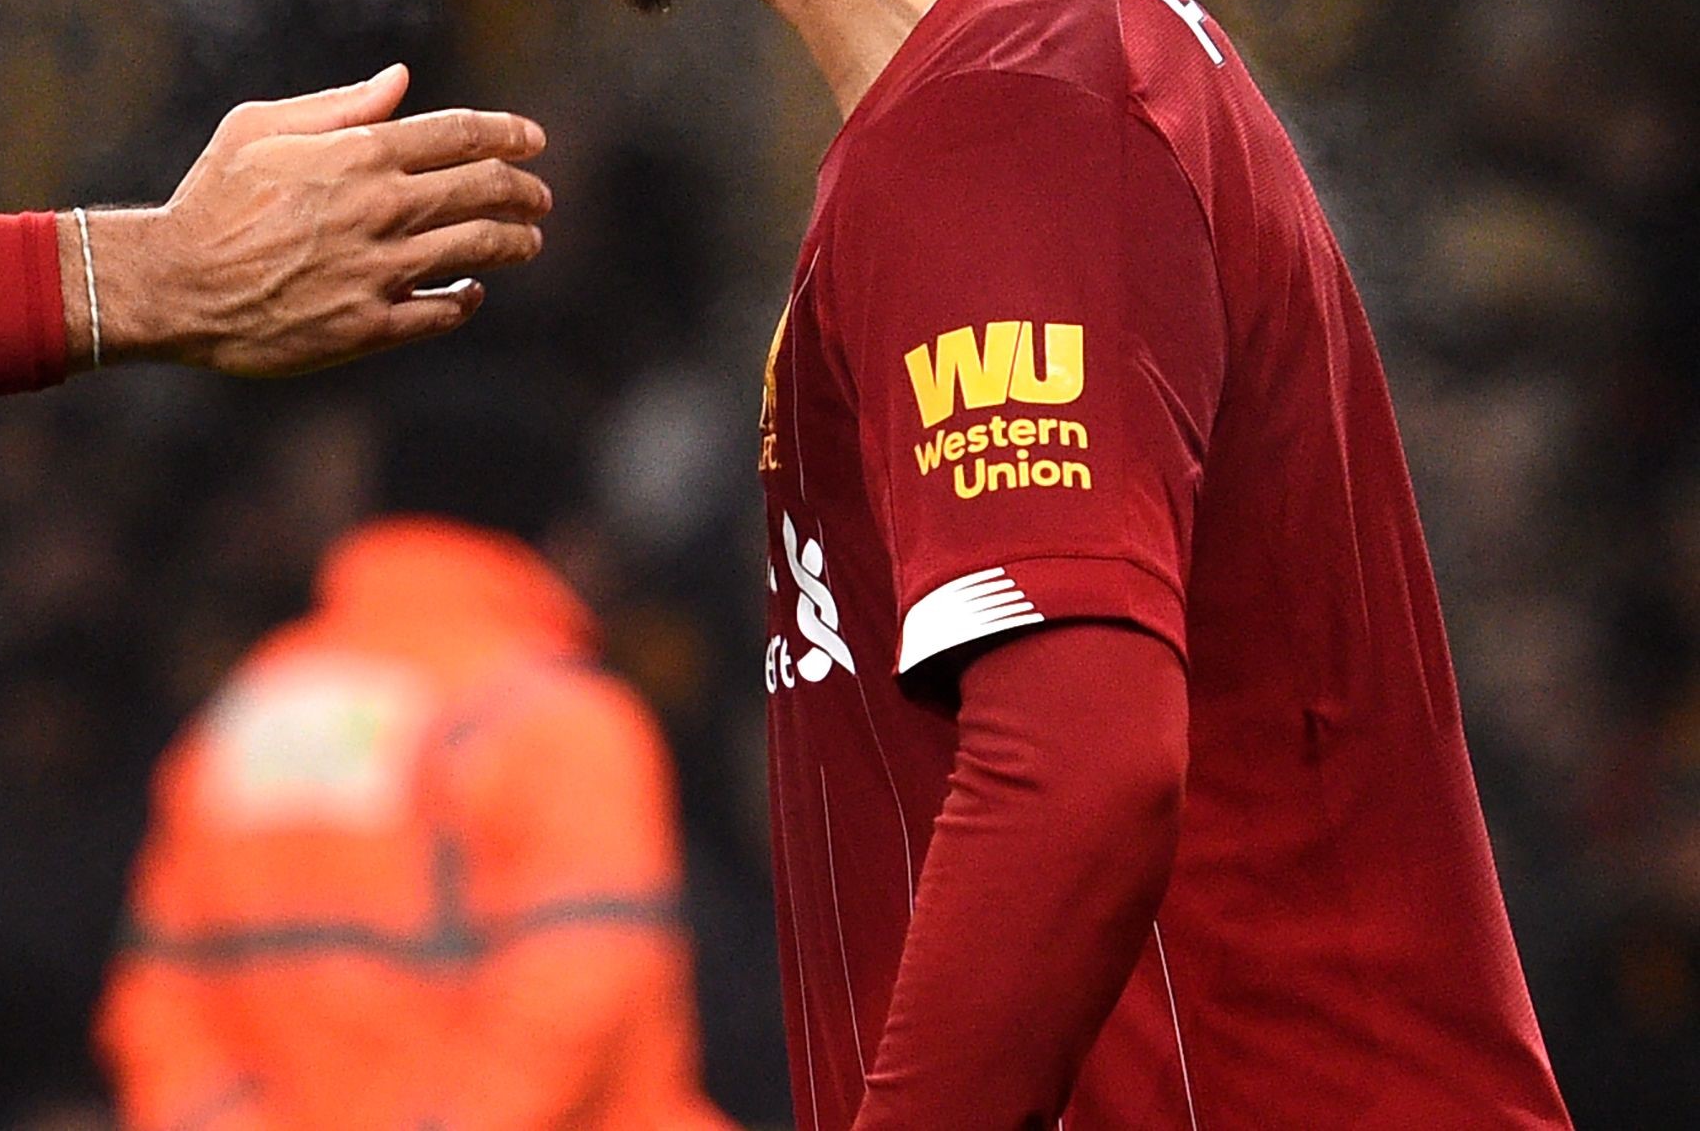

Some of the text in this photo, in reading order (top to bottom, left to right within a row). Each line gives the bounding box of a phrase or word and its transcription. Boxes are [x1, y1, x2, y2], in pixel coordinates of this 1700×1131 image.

[904, 321, 1084, 429] WU
[914, 415, 1088, 476] Western
[953, 448, 1092, 499] Union
